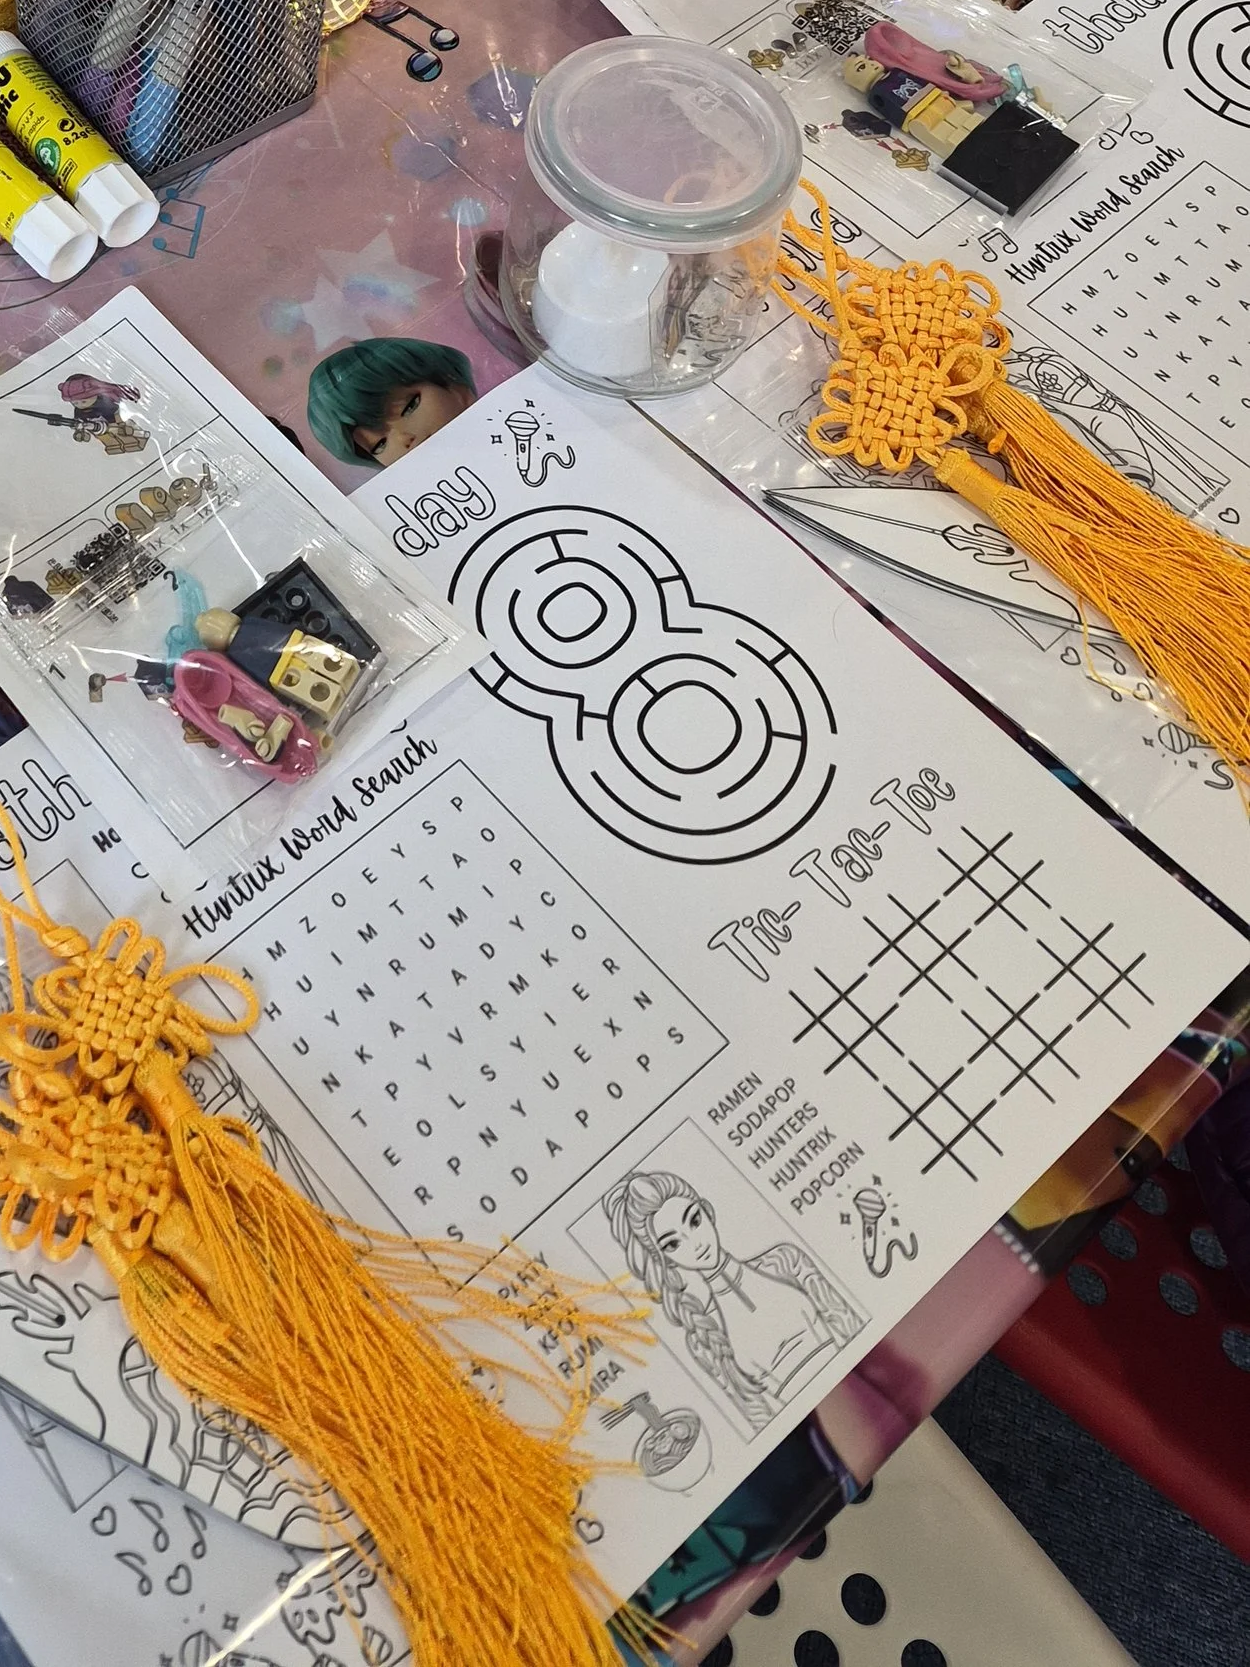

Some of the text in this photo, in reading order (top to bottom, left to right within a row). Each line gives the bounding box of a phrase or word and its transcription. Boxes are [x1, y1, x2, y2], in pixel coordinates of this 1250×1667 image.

[1004, 146, 1186, 286] Huntrix Word Search
[182, 735, 438, 939] Huntrix Word Search
[707, 1070, 763, 1126] RAMEN
[727, 1077, 796, 1147] SODAPOP
[748, 1101, 819, 1170] HUNTERS
[768, 1125, 837, 1192] HUNTRIX
[790, 1140, 865, 1216] POPCORN
